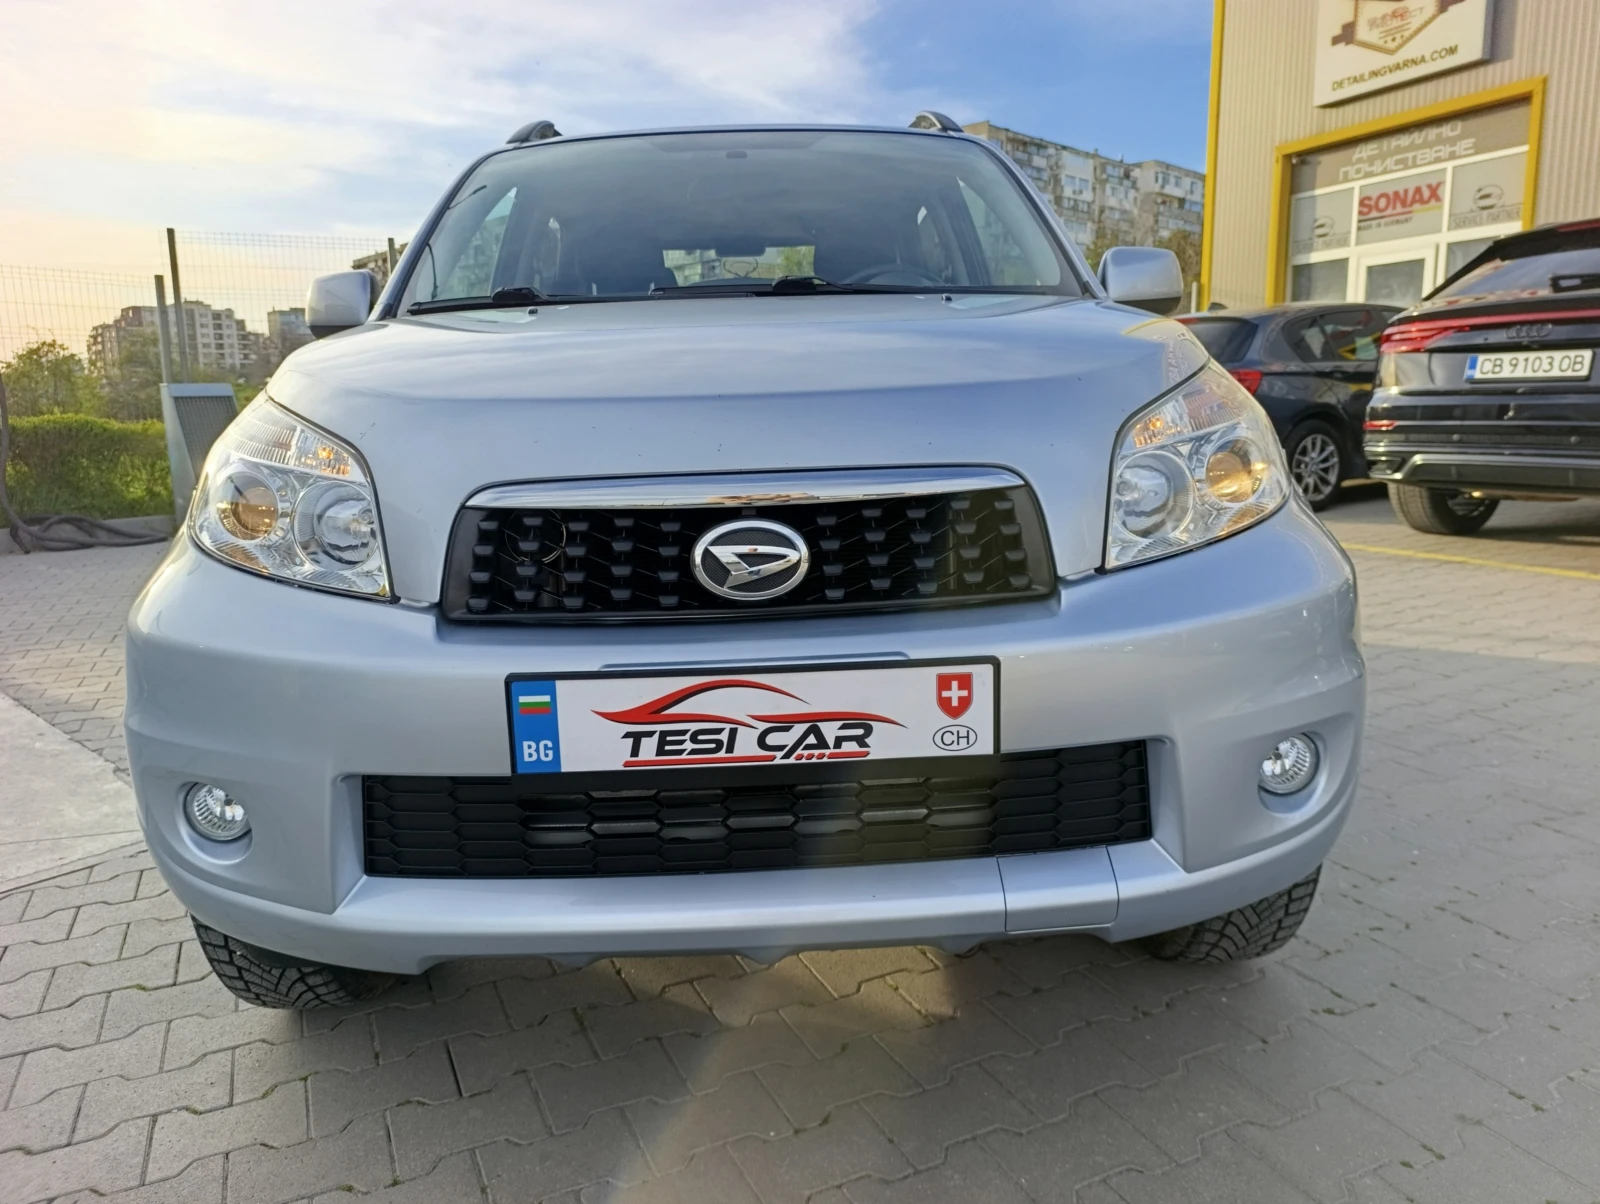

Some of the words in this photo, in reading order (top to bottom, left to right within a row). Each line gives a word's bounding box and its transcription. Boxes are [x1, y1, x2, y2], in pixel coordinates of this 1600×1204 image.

[1331, 44, 1459, 92] DETAILINGVARNA.COM
[1338, 138, 1476, 182] ПОЧИСТВАНЕ
[1358, 181, 1444, 216] SONAX
[1479, 358, 1504, 375] CB
[1509, 355, 1555, 374] 9103
[522, 741, 554, 762] BG
[620, 727, 738, 758] TESI
[756, 722, 874, 760] CAR
[940, 730, 971, 747] CH
